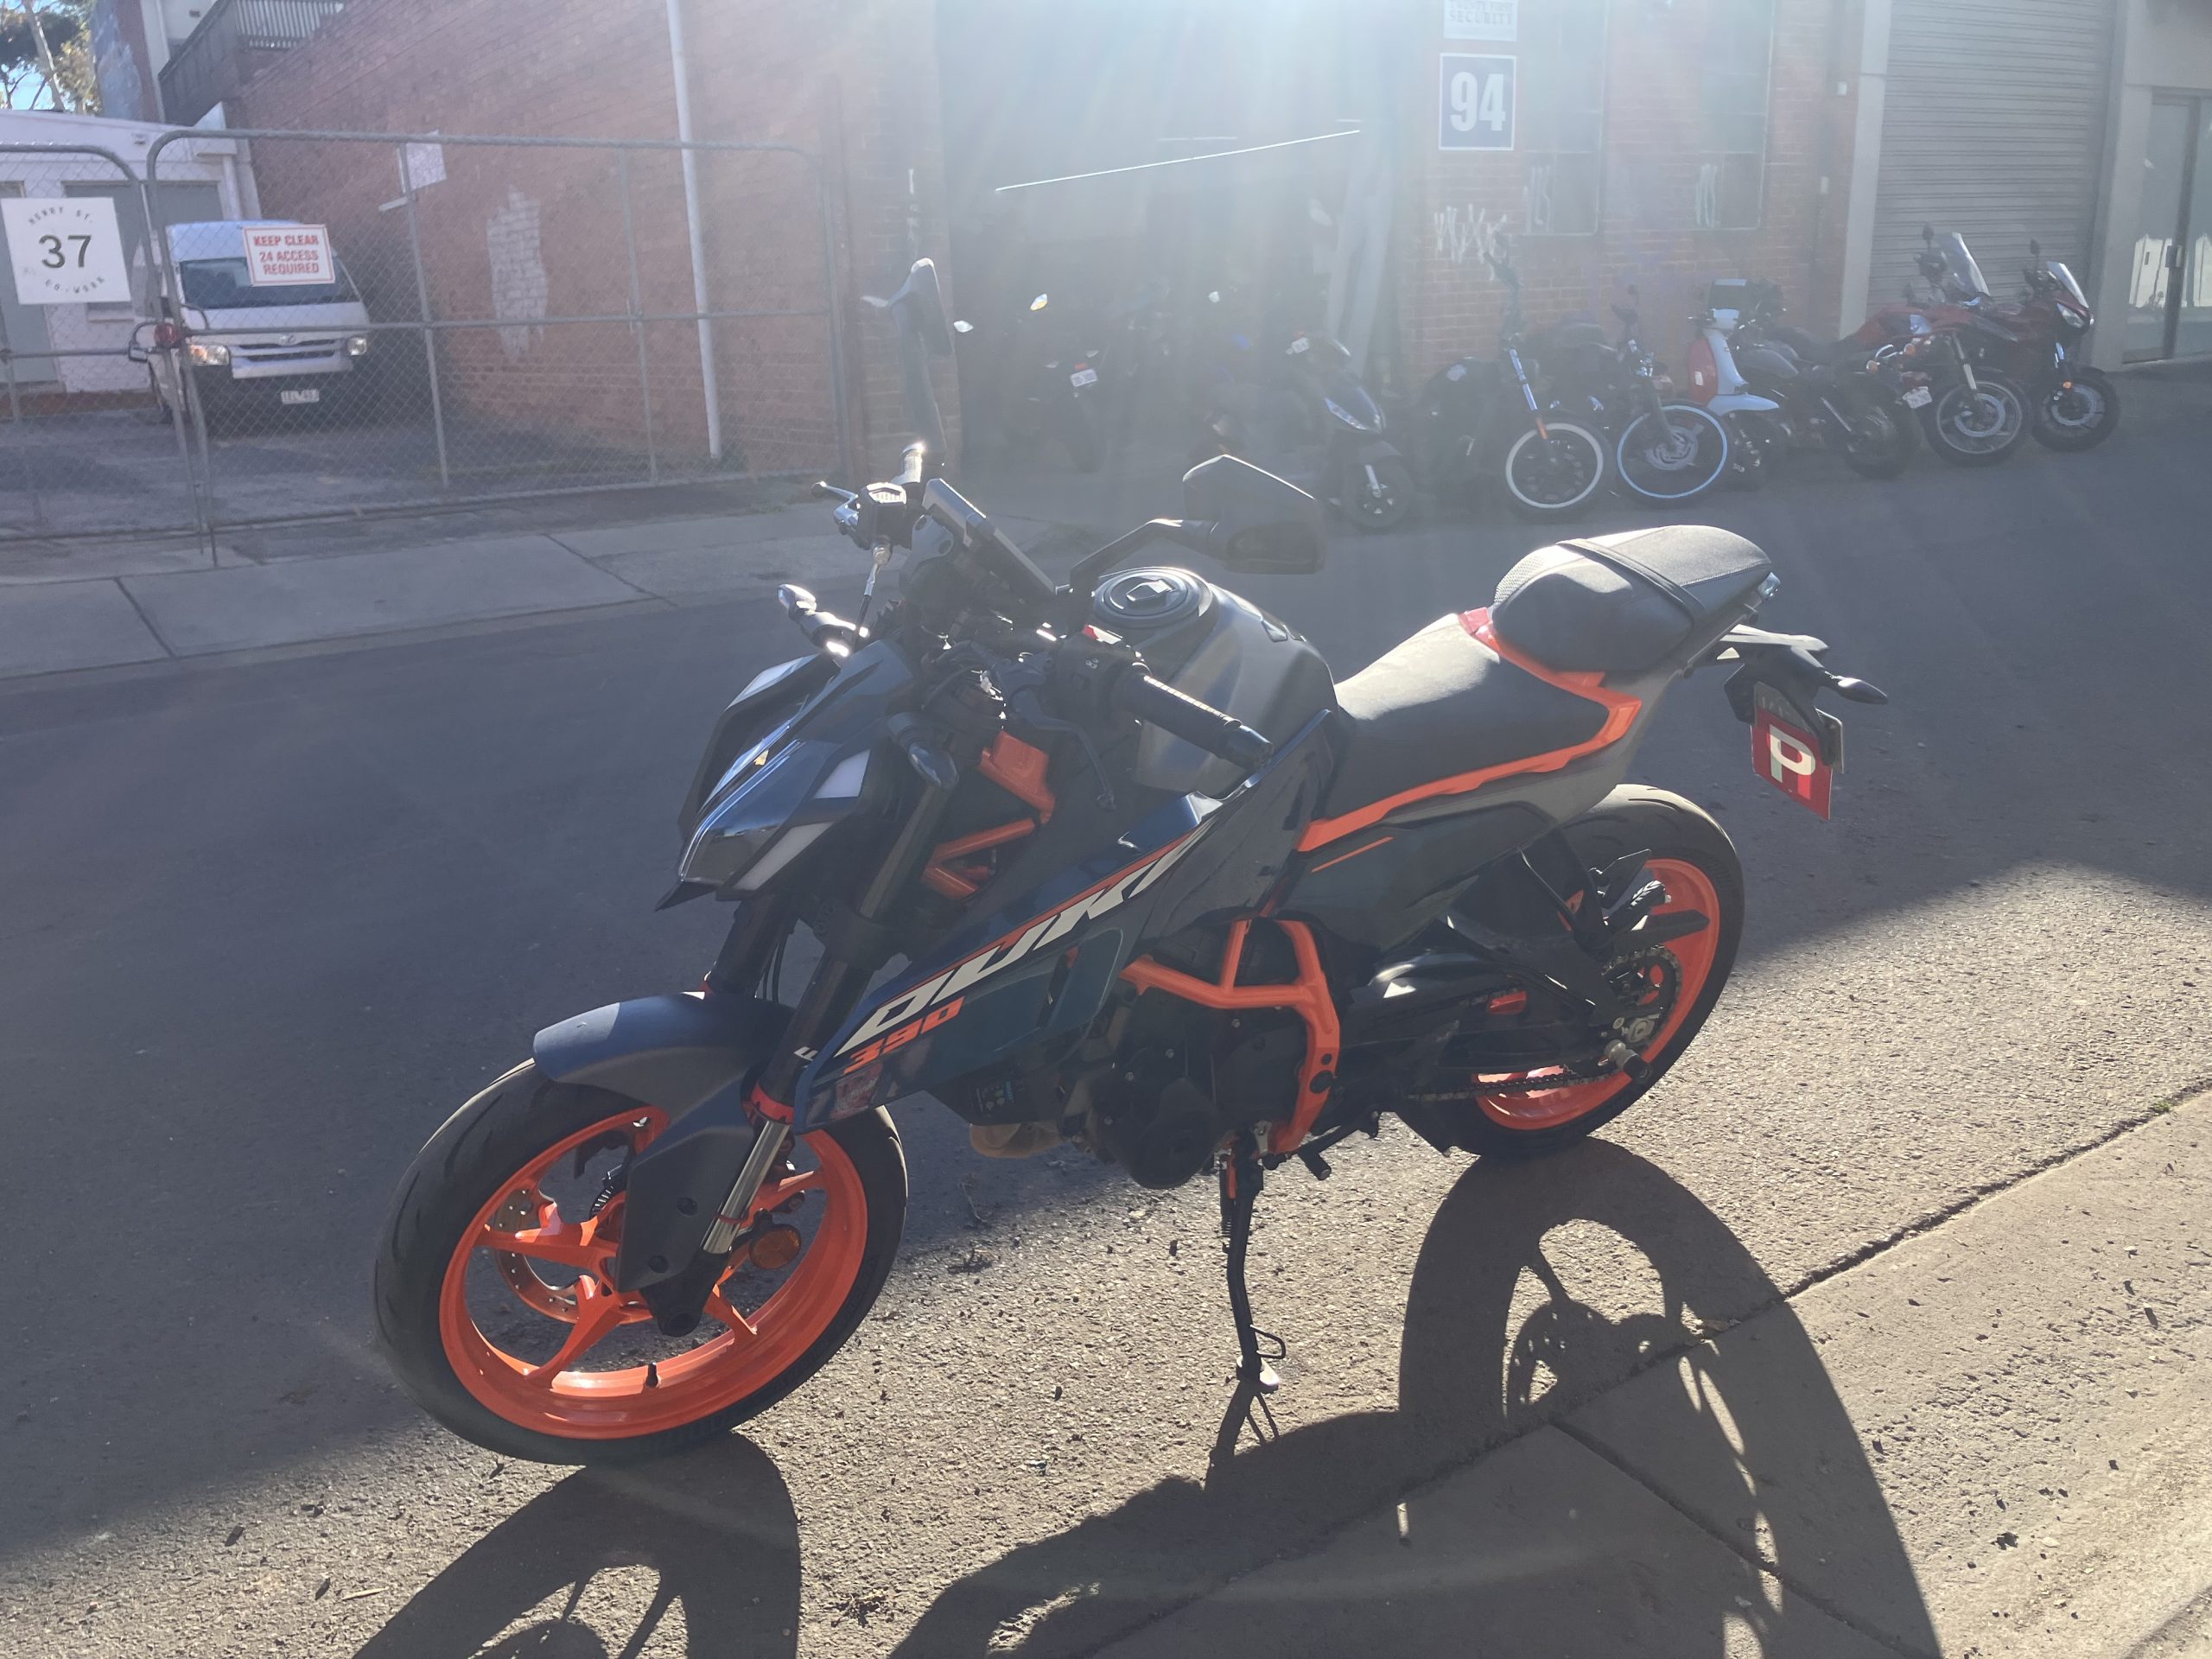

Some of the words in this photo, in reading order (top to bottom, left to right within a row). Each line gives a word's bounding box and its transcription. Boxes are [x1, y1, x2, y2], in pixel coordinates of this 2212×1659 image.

[1449, 10, 1514, 25] SECURITY
[1449, 71, 1506, 132] 94
[38, 234, 92, 269] 37
[253, 235, 281, 246] KEEP
[284, 234, 319, 246] CLEAR
[258, 251, 274, 264] 24
[276, 249, 319, 263] ACCESS
[263, 262, 320, 276] REQUIRED
[1769, 724, 1816, 784] P
[843, 995, 965, 1076] 390
